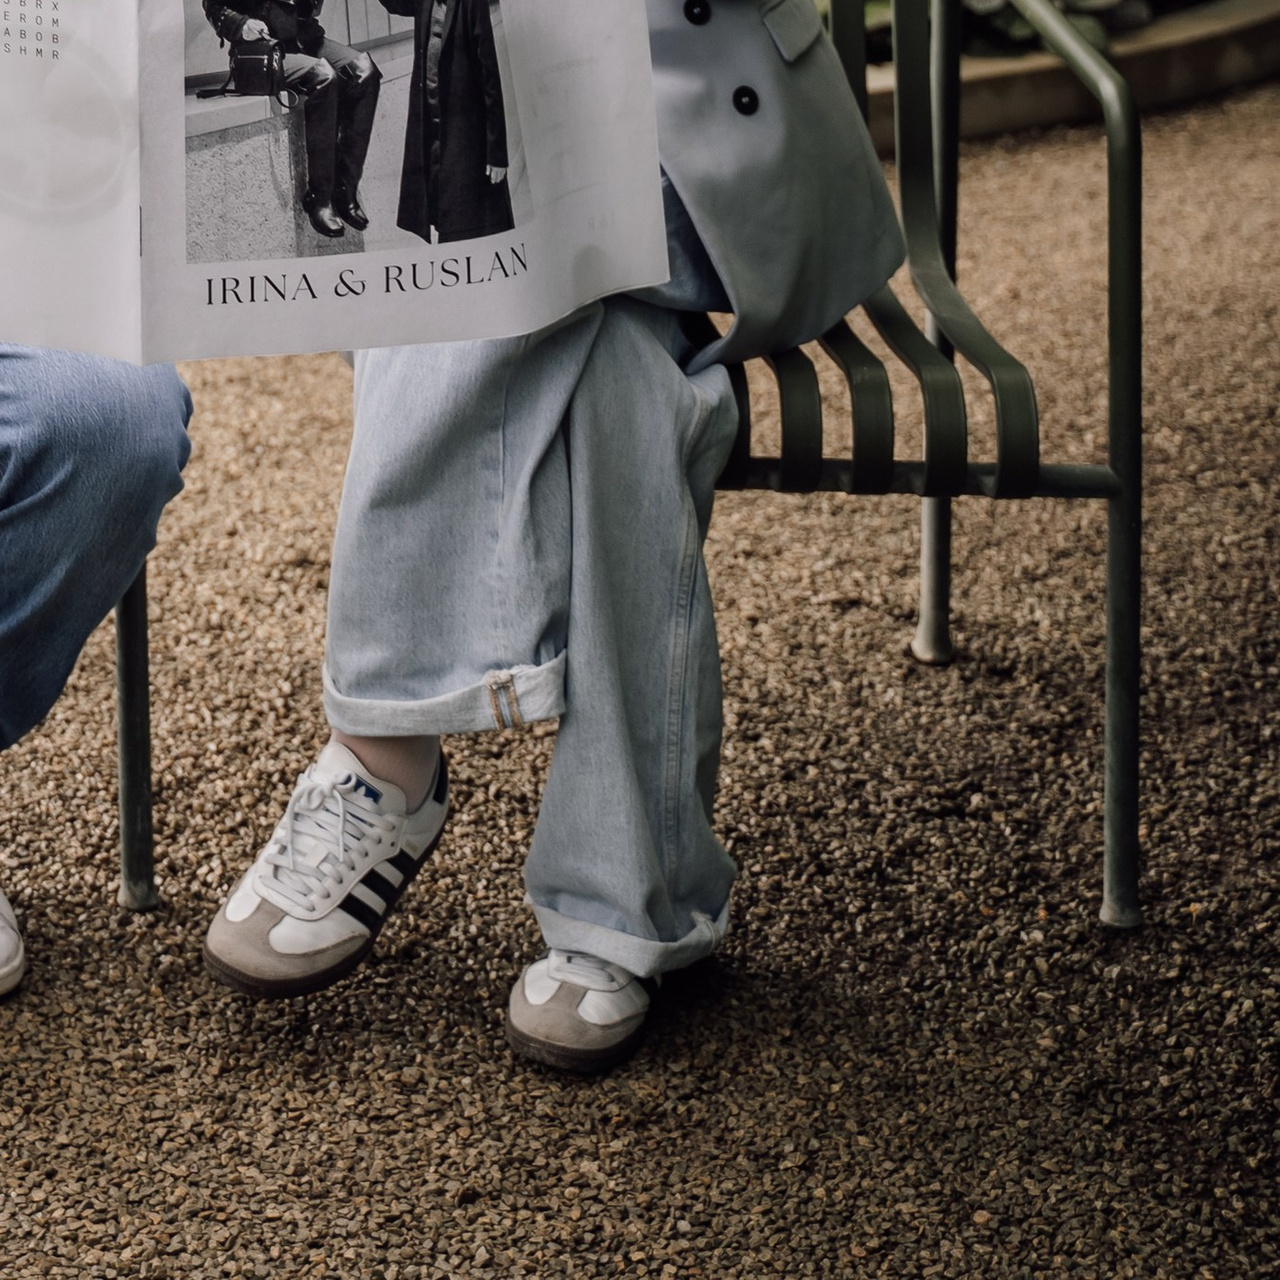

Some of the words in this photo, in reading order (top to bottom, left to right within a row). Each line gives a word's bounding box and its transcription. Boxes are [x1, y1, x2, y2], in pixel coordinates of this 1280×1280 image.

[205, 272, 318, 307] IRINA
[333, 268, 367, 300] &
[383, 243, 530, 294] RUSLAN
